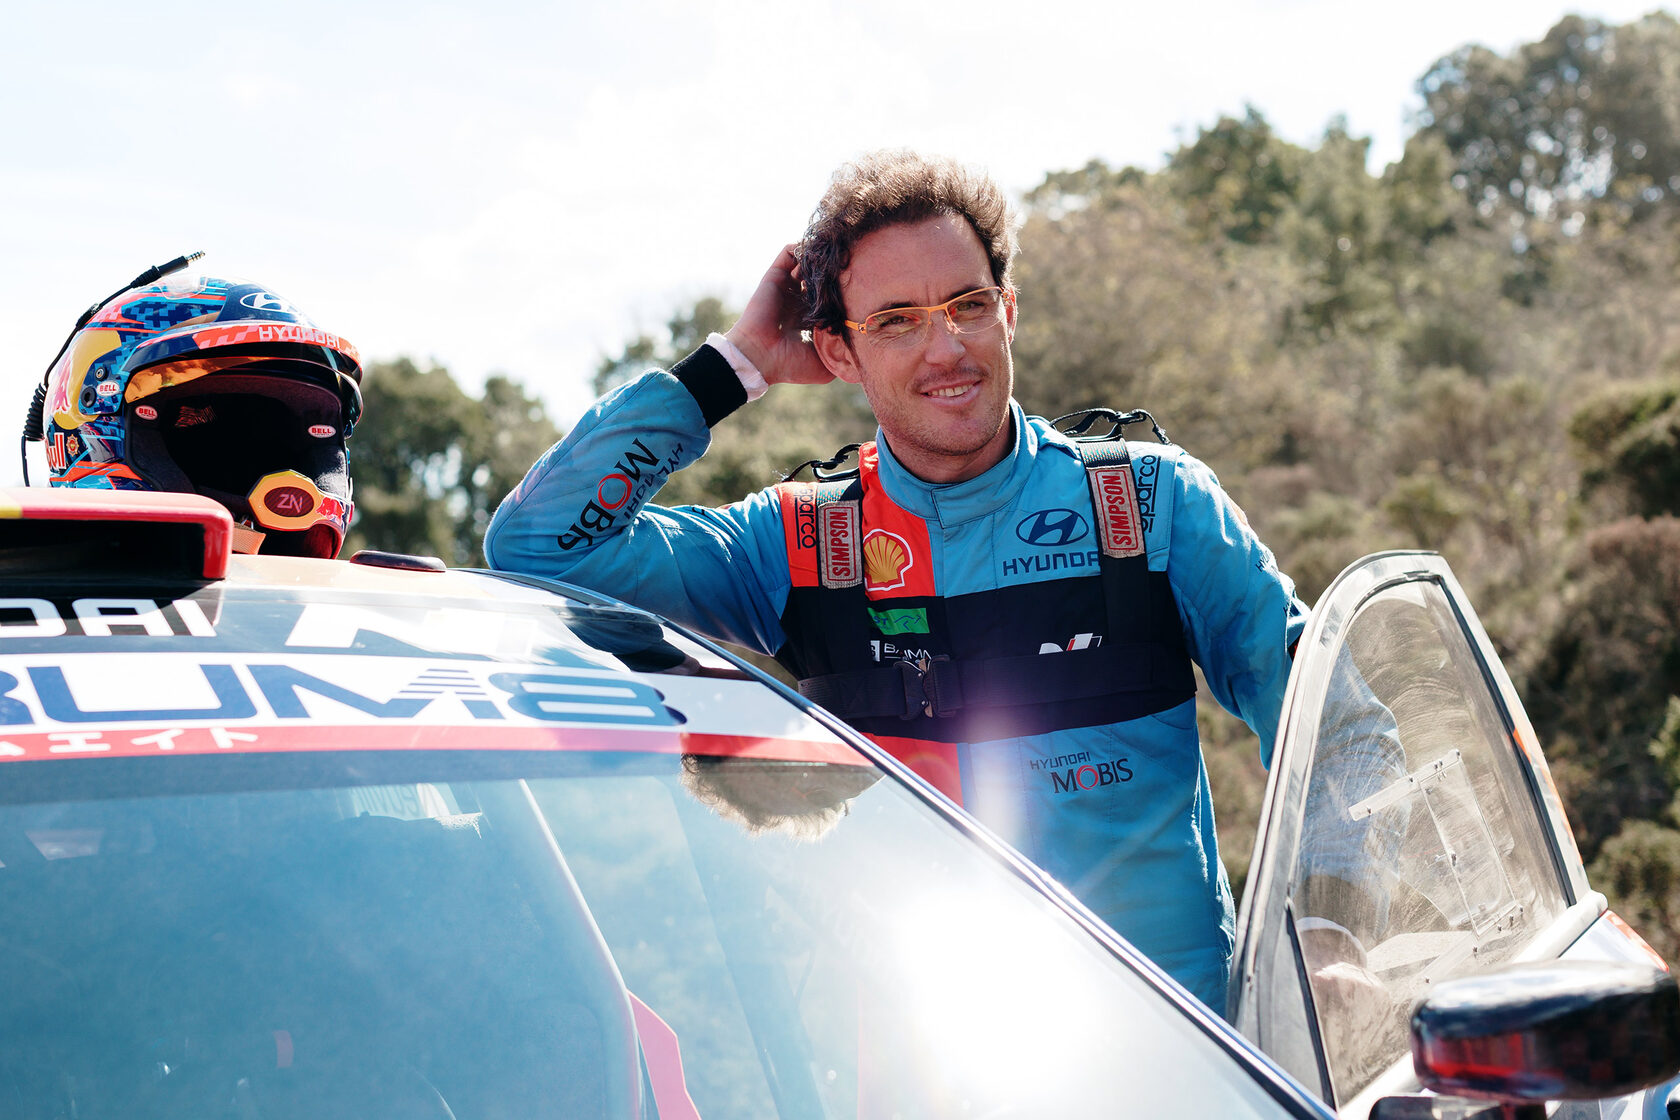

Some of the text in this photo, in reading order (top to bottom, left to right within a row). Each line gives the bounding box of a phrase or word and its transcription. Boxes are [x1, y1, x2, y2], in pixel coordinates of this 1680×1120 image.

[99, 384, 117, 392] BELL
[138, 408, 156, 417] BELL
[557, 437, 661, 551] MOBIS
[1101, 474, 1133, 546] SIMPSON
[829, 511, 851, 577] SIMPSON
[1002, 551, 1101, 576] HYUNDA
[1030, 752, 1091, 770] HYUNDAI
[1050, 758, 1134, 794] MOBIS
